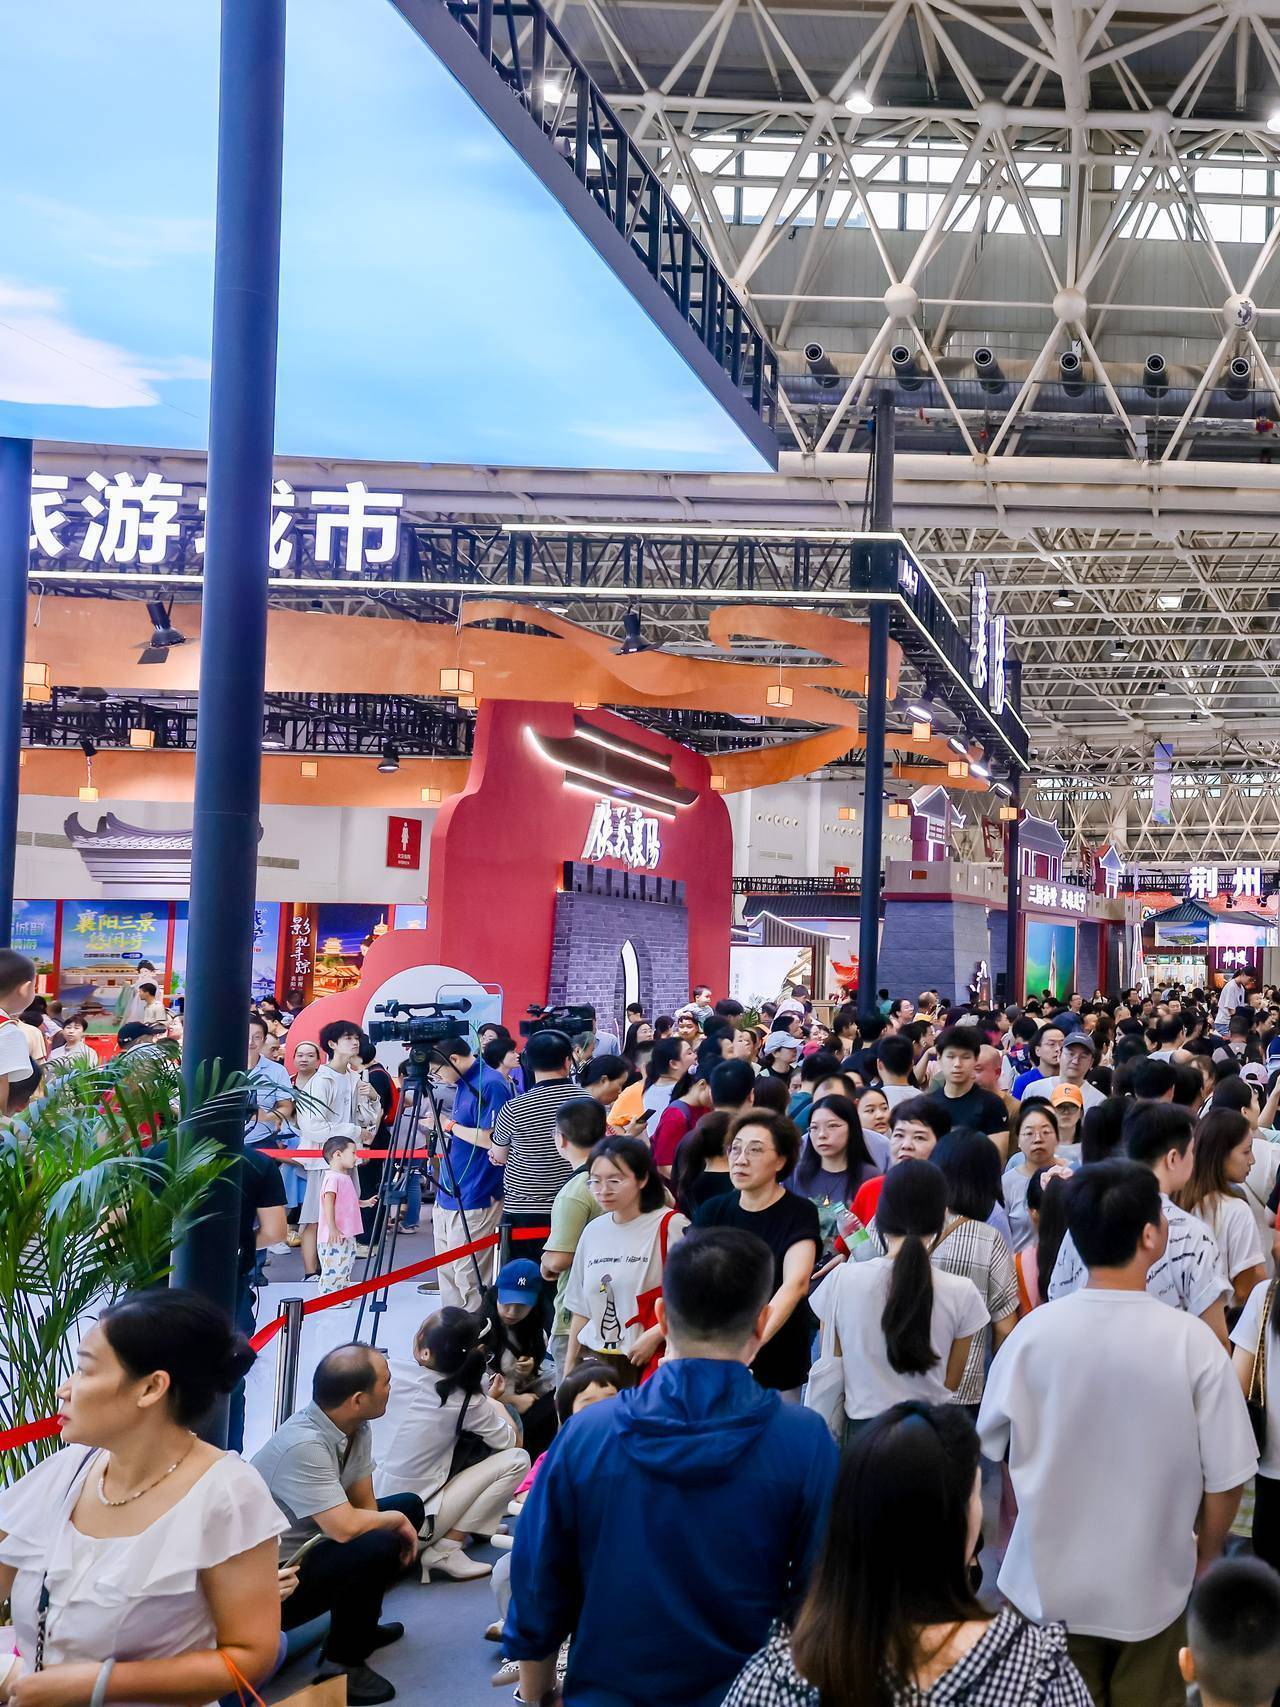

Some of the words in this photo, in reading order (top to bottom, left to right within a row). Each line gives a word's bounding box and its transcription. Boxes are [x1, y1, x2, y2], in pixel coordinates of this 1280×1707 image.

[1189, 866, 1262, 898] 荆州
[72, 909, 157, 933] 襄阳三景
[290, 917, 311, 975] 影视寻踪
